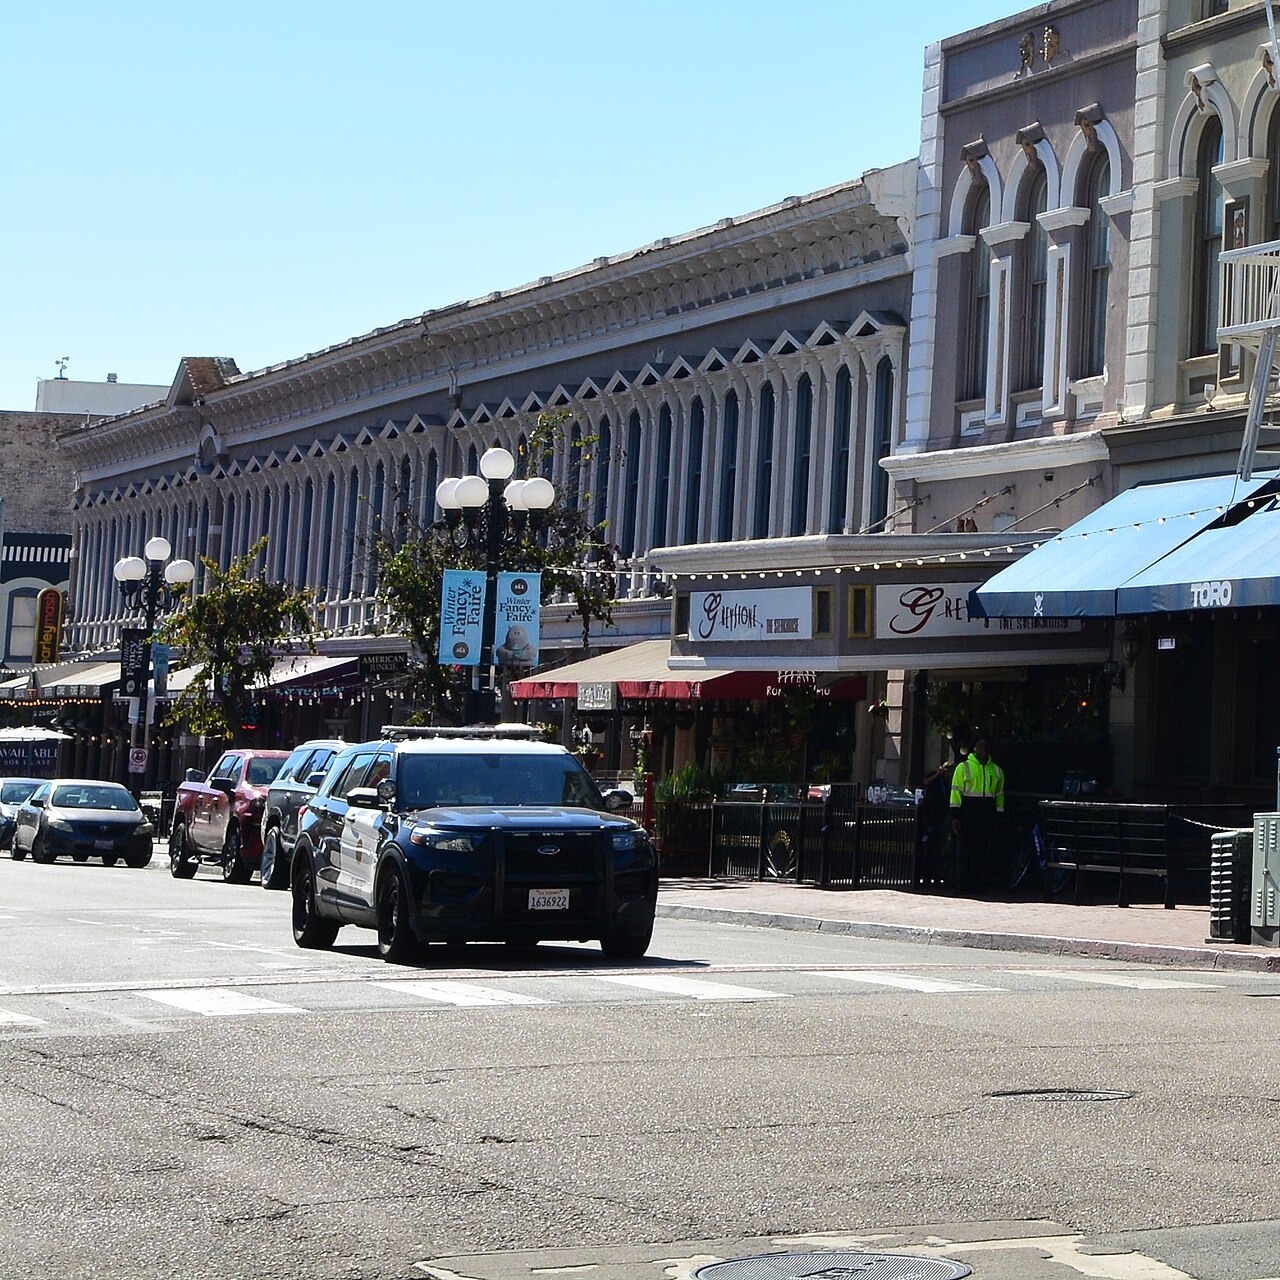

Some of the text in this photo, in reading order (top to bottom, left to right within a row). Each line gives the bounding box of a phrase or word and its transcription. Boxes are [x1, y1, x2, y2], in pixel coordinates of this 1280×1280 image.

[1190, 581, 1232, 607] TORO
[444, 586, 456, 625] Winter
[467, 585, 482, 626] Faire
[507, 597, 532, 605] Winter
[452, 587, 471, 636] Fancy
[500, 603, 532, 615] Fancy
[506, 612, 533, 622] Faire
[361, 655, 405, 664] AMERICAN
[532, 896, 567, 908] 1636922
